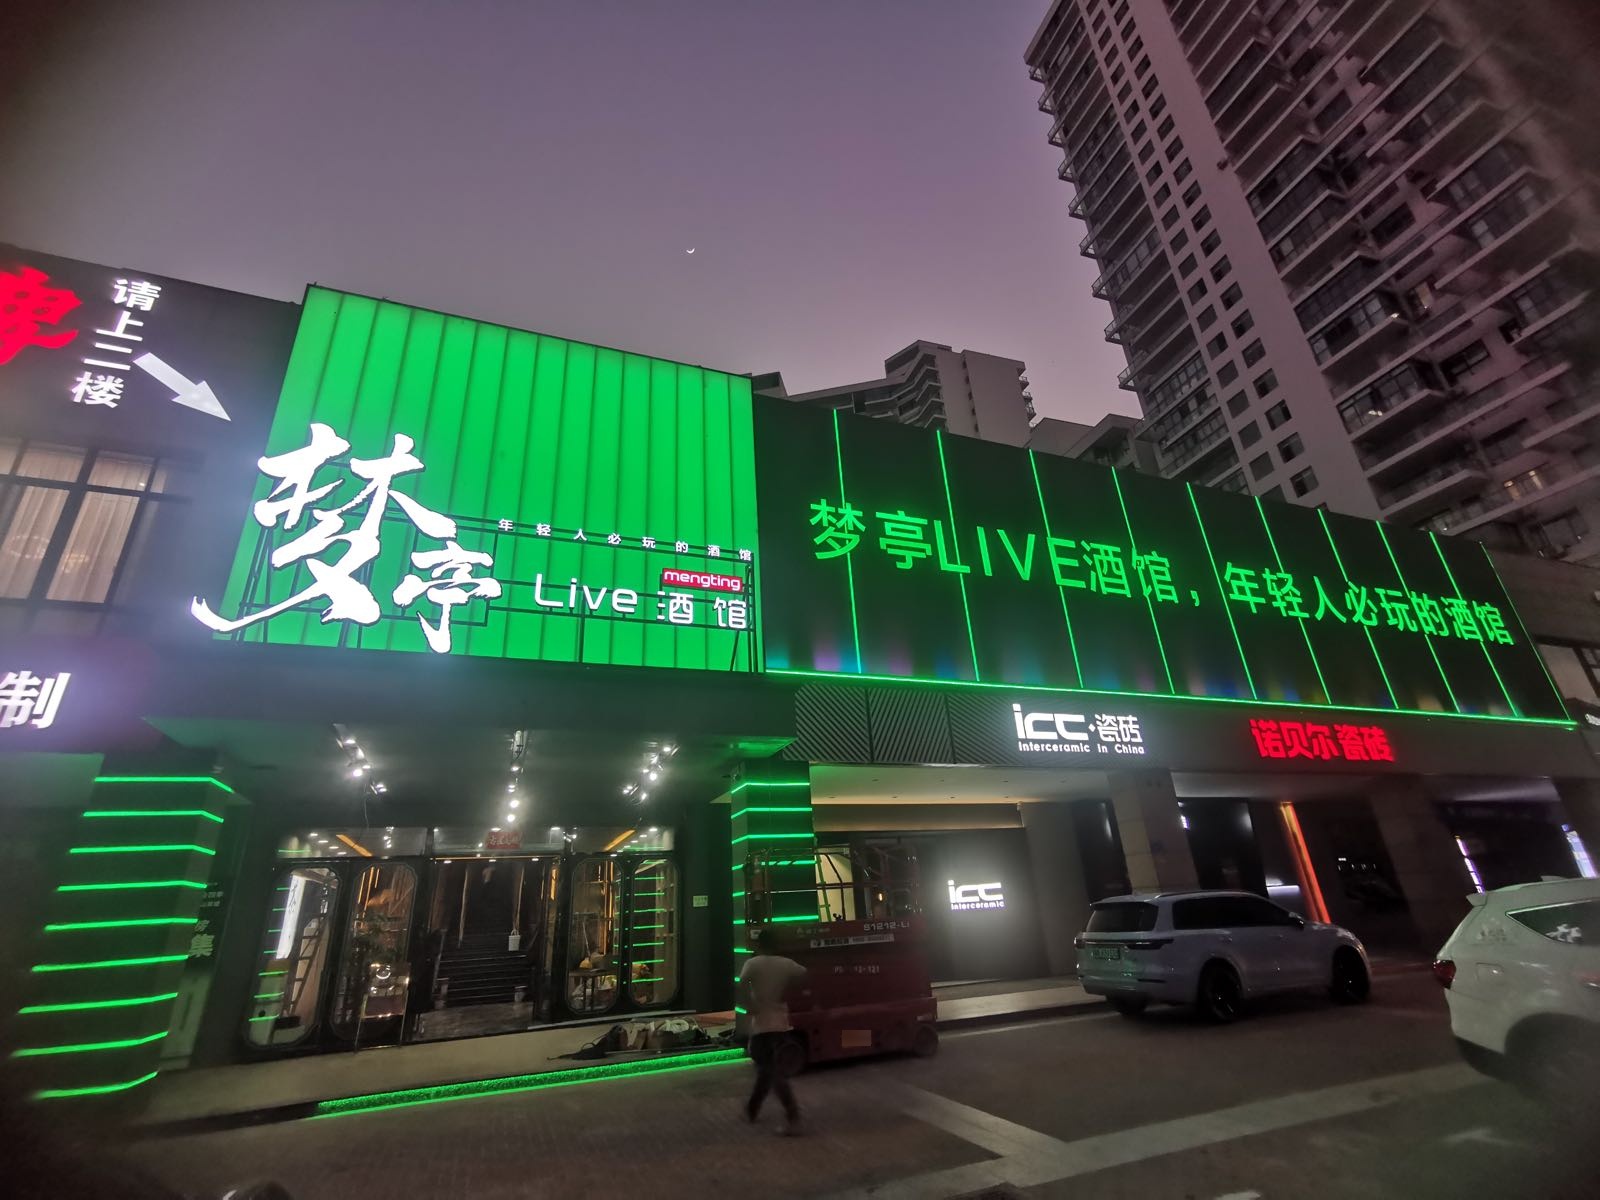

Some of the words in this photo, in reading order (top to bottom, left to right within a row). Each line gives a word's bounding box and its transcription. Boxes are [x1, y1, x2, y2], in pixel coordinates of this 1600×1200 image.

[71, 278, 162, 409] 请上二楼
[498, 518, 752, 561] 年轻人必玩的酒馆
[534, 573, 638, 614] Live
[656, 591, 748, 630] 酒馆
[663, 570, 742, 592] mengting
[1018, 741, 1091, 753] Interceramic
[1114, 743, 1146, 755] China
[1249, 719, 1396, 762] 诺贝尔瓷砖
